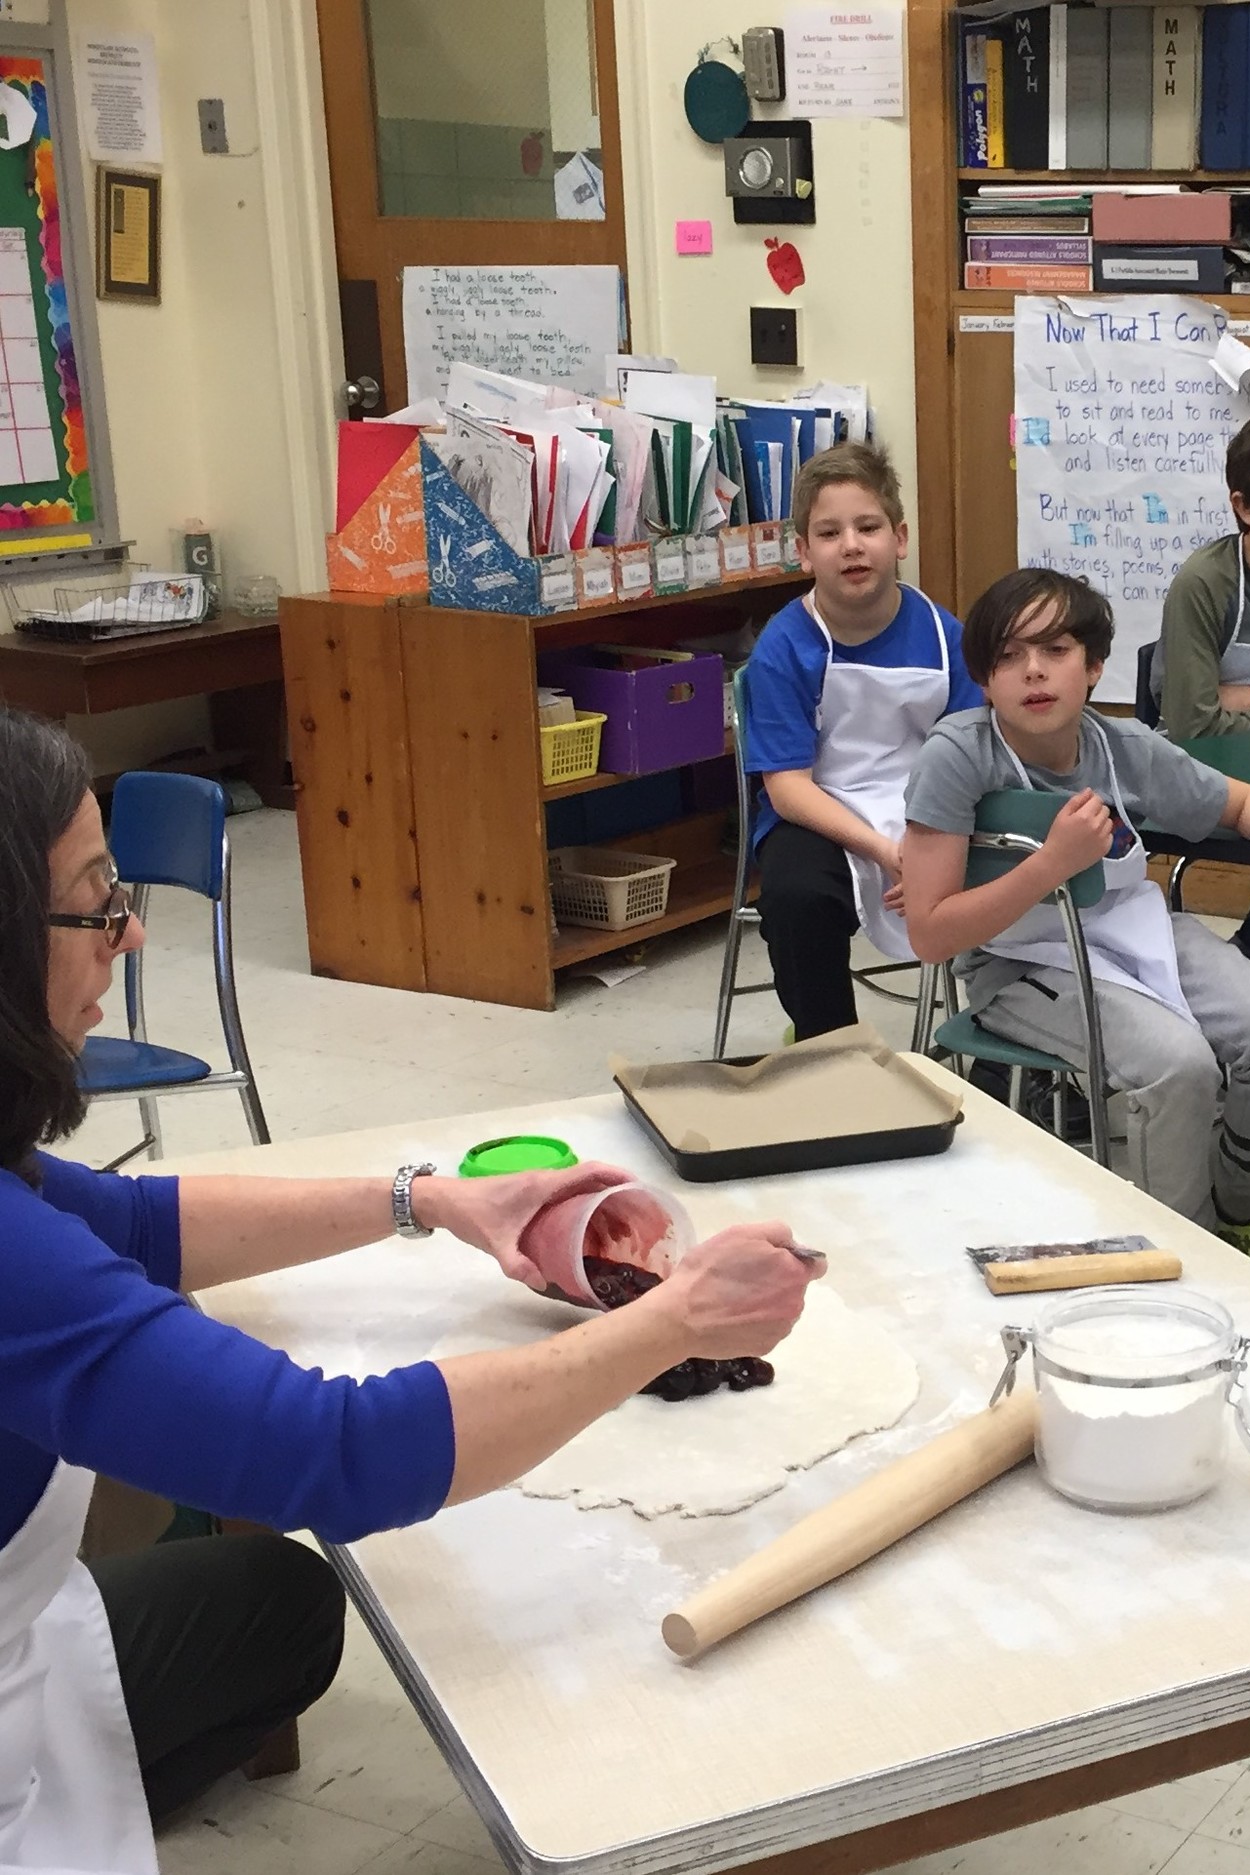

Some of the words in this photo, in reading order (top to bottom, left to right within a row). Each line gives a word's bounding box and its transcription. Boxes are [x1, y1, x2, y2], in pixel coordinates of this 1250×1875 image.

[1016, 17, 1038, 93] MATH
[1165, 18, 1179, 96] MATH
[433, 268, 440, 281] I
[446, 270, 461, 282] had
[478, 268, 504, 282] loose
[432, 294, 439, 305] I
[445, 295, 461, 306] had
[466, 297, 473, 306] a
[475, 308, 486, 321] by
[495, 309, 501, 317] a
[437, 325, 444, 340] I
[452, 329, 476, 343] pulled
[483, 332, 497, 343] my
[506, 329, 530, 341] loose
[1046, 313, 1086, 343] Now
[1090, 312, 1139, 342] That
[1150, 311, 1161, 341] I
[1175, 313, 1210, 342] Can
[530, 341, 555, 354] loose
[530, 367, 541, 375] to
[535, 357, 549, 370] my
[1046, 366, 1058, 392] I
[1066, 367, 1098, 394] used
[1107, 371, 1123, 394] to
[1131, 367, 1166, 393] need
[1056, 400, 1071, 419] to
[1083, 401, 1104, 421] sit
[1110, 402, 1134, 421] and
[1142, 400, 1174, 421] read
[1185, 404, 1201, 421] to
[1210, 406, 1240, 423] me.
[1065, 425, 1097, 446] look
[1108, 430, 1124, 446] at
[1132, 432, 1169, 451] every
[1178, 432, 1215, 456] page
[1065, 450, 1091, 472] and
[1107, 451, 1147, 472] listen
[1040, 493, 1068, 522] But
[1077, 508, 1101, 522] now
[1105, 498, 1135, 523] that
[1142, 491, 1169, 524] I'm
[1178, 507, 1188, 525] in
[1193, 496, 1230, 526] first
[1068, 522, 1097, 548] I'm
[1103, 525, 1141, 559] filling
[1150, 537, 1167, 560] up
[1172, 535, 1183, 551] a
[192, 546, 208, 566] G
[1027, 548, 1057, 569] with
[1062, 553, 1115, 579] stories,
[1123, 560, 1167, 582] poems,
[1102, 574, 1112, 599] I
[1122, 586, 1149, 600] can
